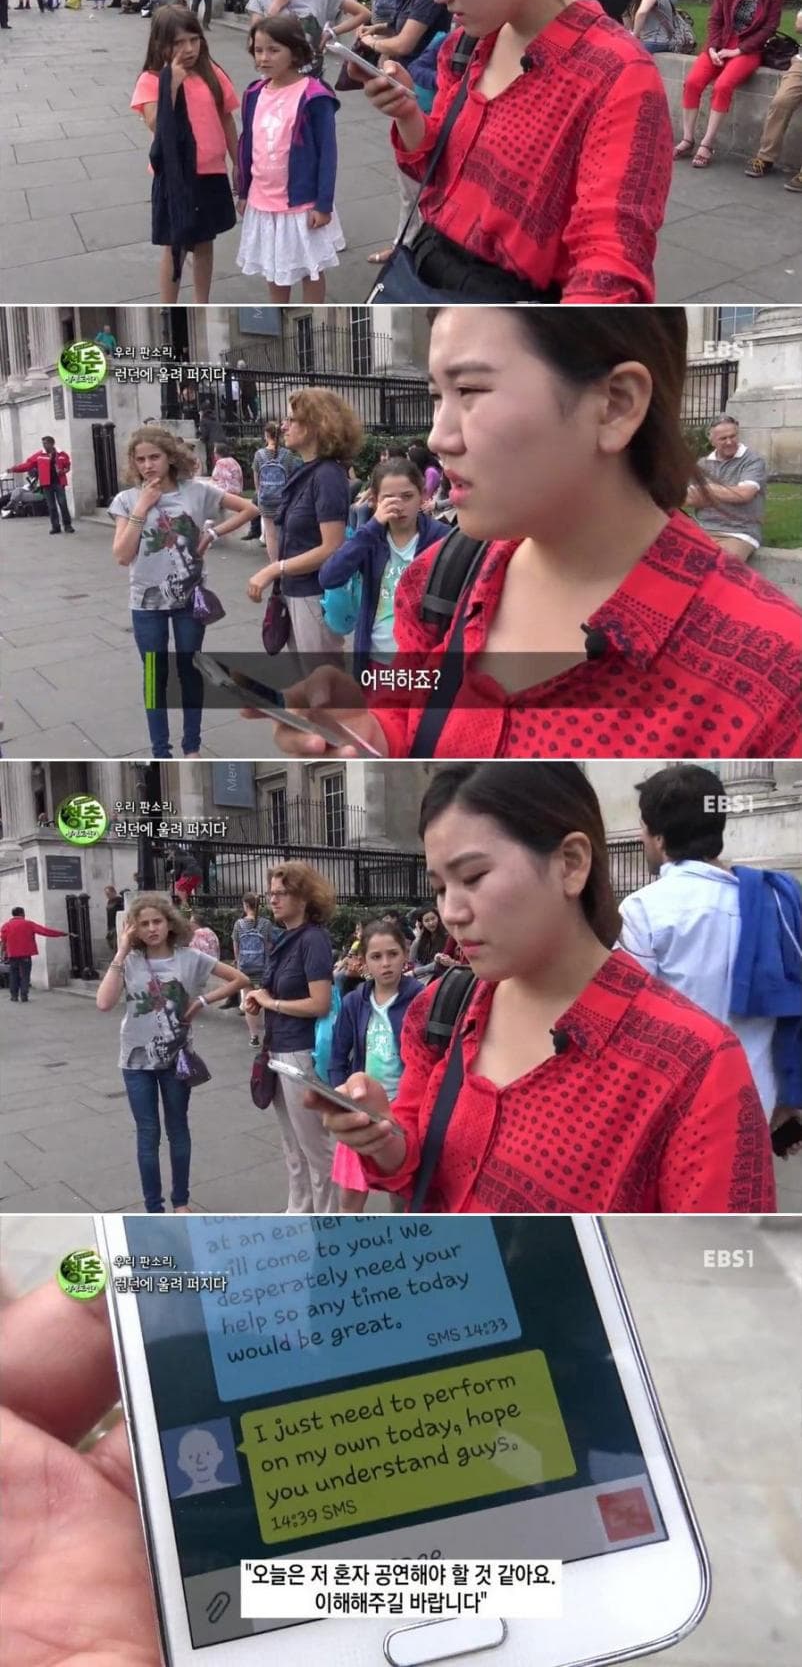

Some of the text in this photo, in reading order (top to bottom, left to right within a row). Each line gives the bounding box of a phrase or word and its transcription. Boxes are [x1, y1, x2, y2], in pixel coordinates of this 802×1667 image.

[206, 1215, 344, 1254] at an earlier
[255, 1249, 311, 1272] come
[315, 1238, 341, 1259] to
[346, 1228, 393, 1259] you!
[400, 1221, 433, 1239] We
[216, 1242, 463, 1310] desperately need your
[221, 1270, 471, 1338] help so any time today
[226, 1315, 403, 1364] would be great.
[425, 1317, 510, 1347] SMS 14:33
[253, 1371, 517, 1444] I just need to perform
[261, 1400, 522, 1474] on my own today, hope
[266, 1434, 519, 1510] you understand guys.
[270, 1499, 359, 1532] 14:39 SMS
